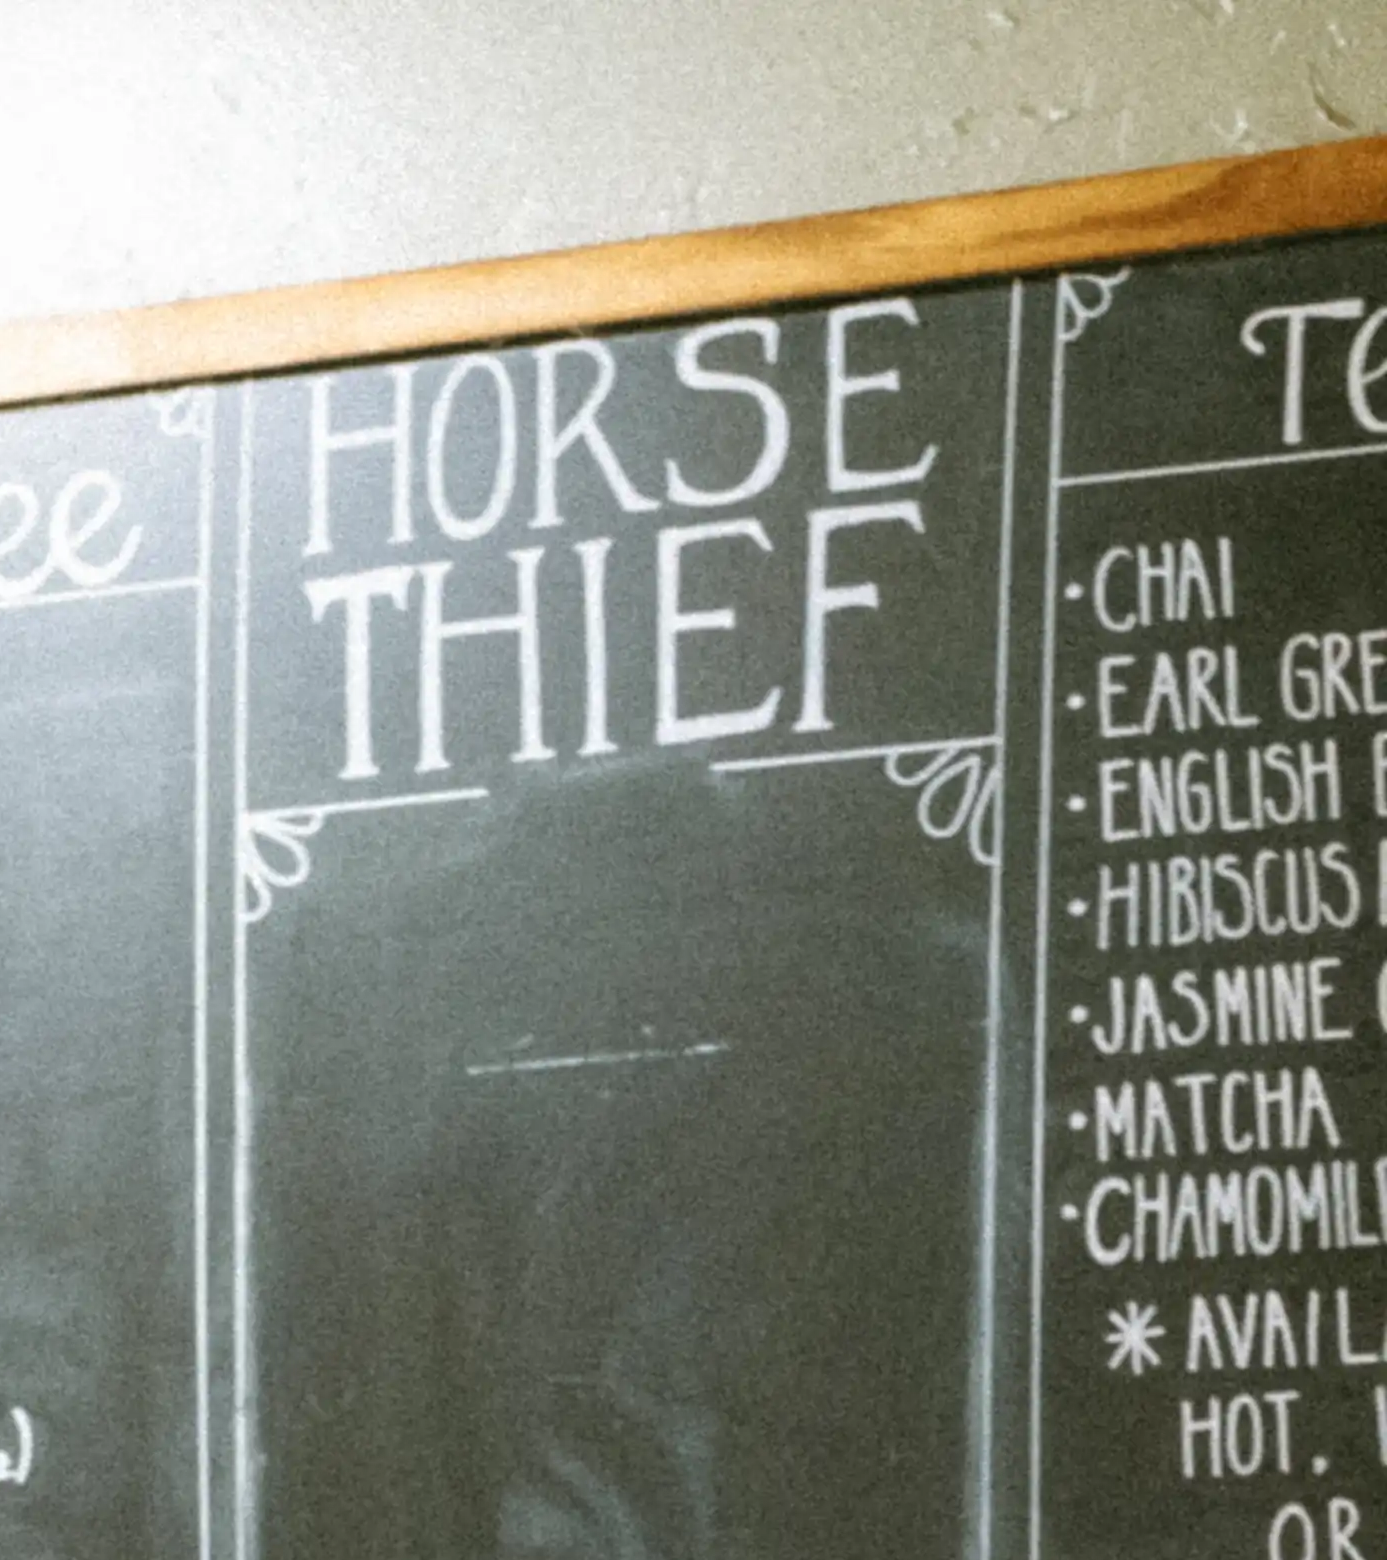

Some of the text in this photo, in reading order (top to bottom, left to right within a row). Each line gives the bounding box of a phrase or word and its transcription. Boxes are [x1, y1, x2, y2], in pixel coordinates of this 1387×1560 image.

[302, 298, 938, 556] HORSE
[1092, 536, 1234, 633] CHAI
[302, 500, 926, 781] THIEF
[1098, 645, 1261, 738] EARL
[1099, 738, 1341, 842] ENGLISH
[1096, 842, 1361, 951] HIBISCUS
[1091, 957, 1354, 1054] JASMINE
[1094, 1066, 1341, 1163] MATCHA
[1186, 1287, 1387, 1373] AVAIL
